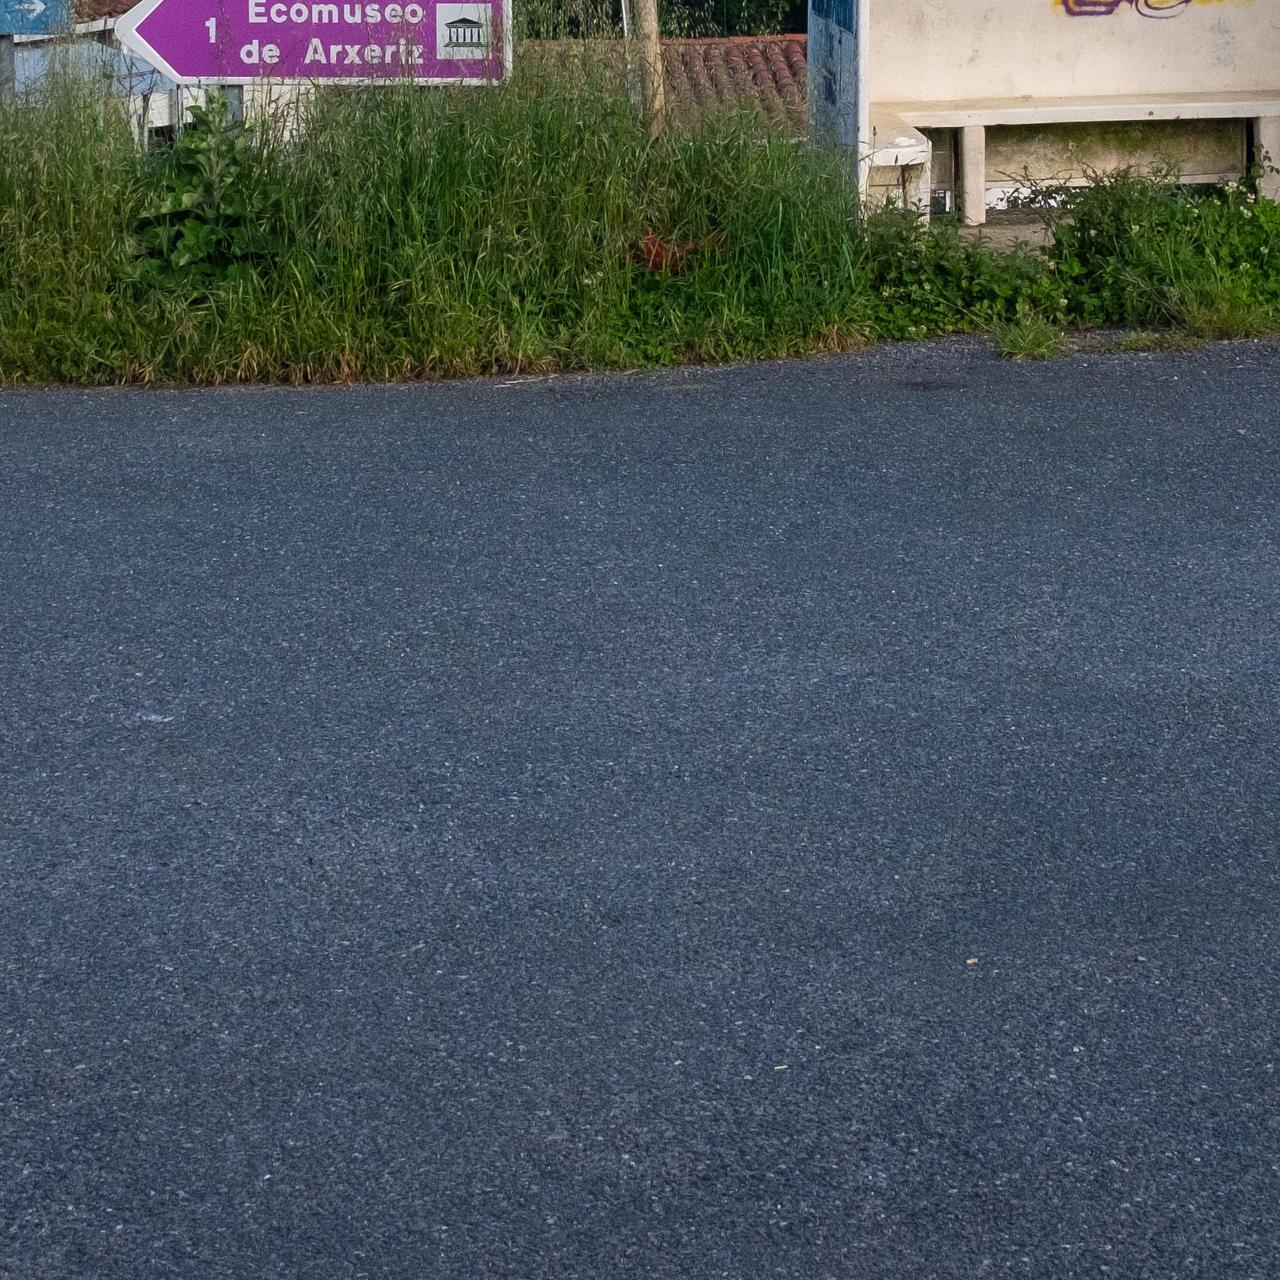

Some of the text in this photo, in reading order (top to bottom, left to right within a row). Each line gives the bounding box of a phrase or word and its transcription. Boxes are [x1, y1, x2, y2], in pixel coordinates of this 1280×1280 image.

[204, 17, 217, 43] 1
[240, 38, 424, 65] de Arxeriz
